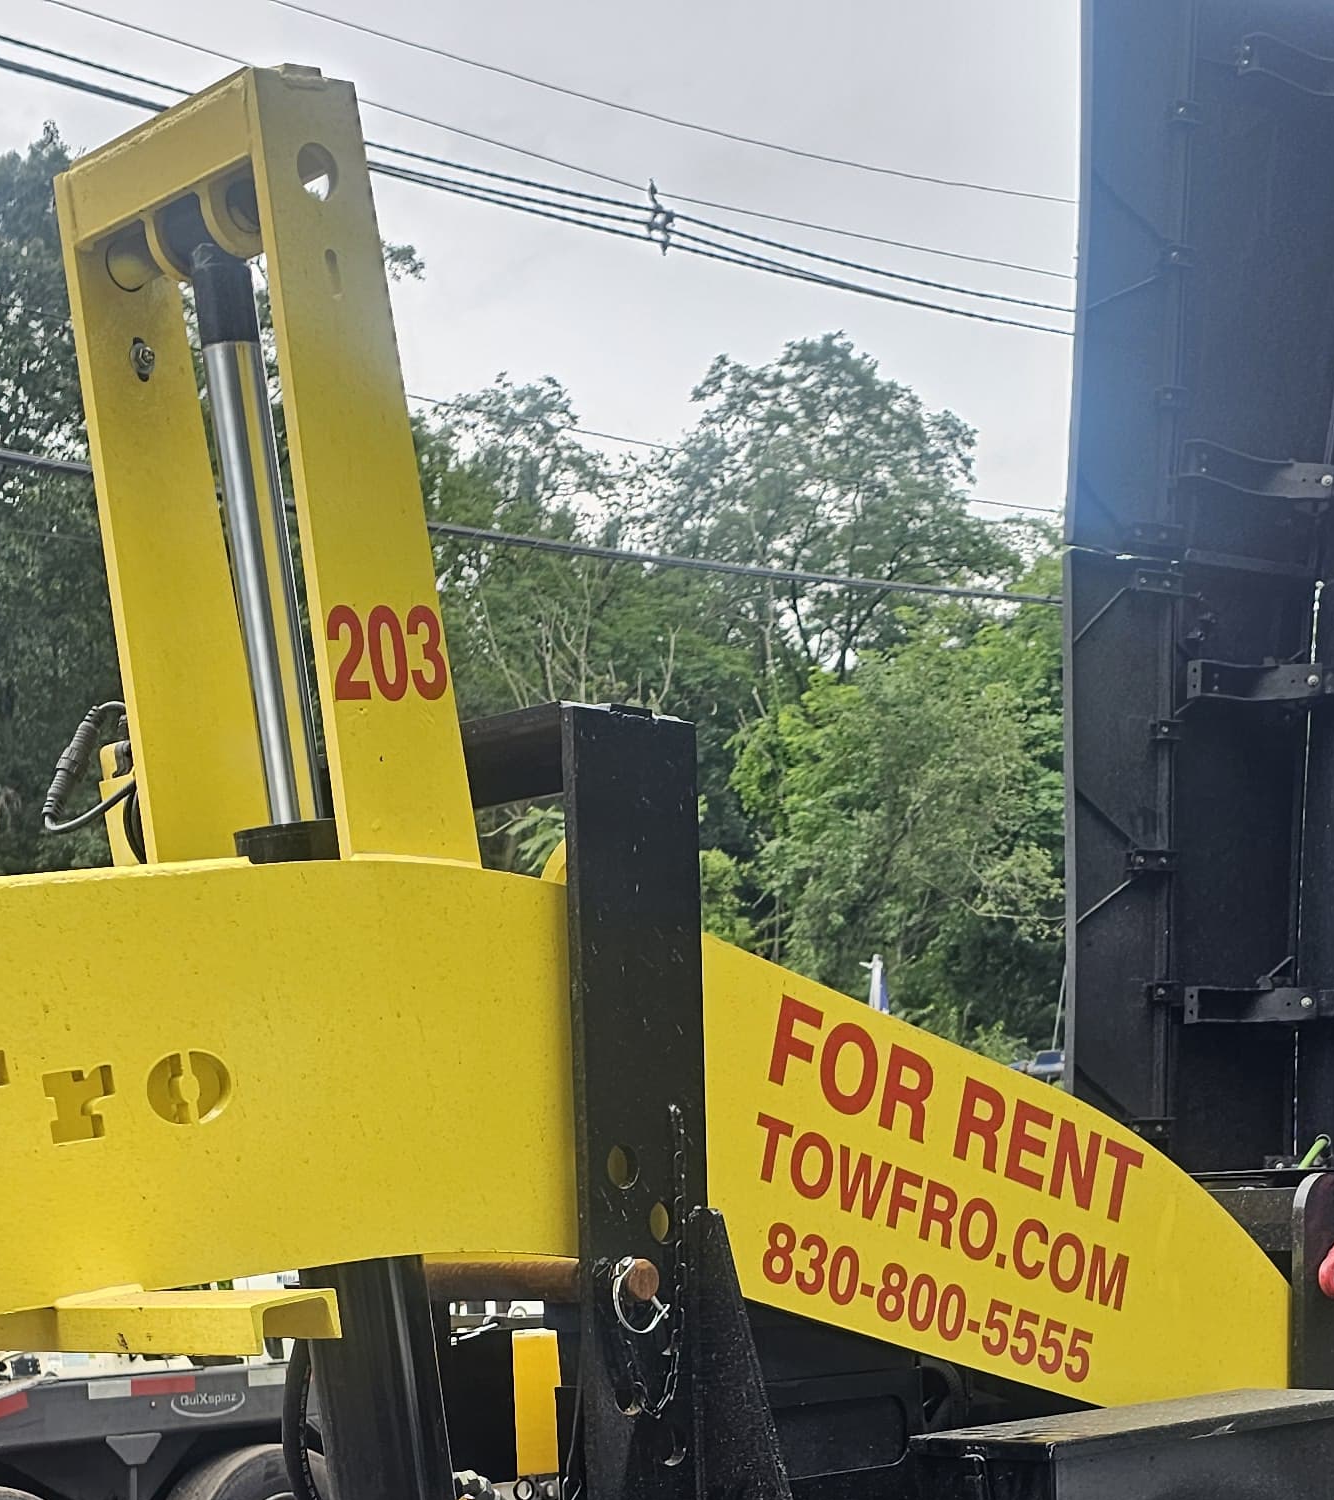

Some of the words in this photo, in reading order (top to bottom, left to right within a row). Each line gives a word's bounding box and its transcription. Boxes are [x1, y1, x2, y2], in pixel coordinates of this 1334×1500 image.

[327, 605, 447, 701] 203
[768, 995, 935, 1144] FOR
[953, 1077, 1144, 1223] RENT
[756, 1113, 1130, 1311] TOWFRO.COM
[762, 1222, 1093, 1383] 830-800-5555
